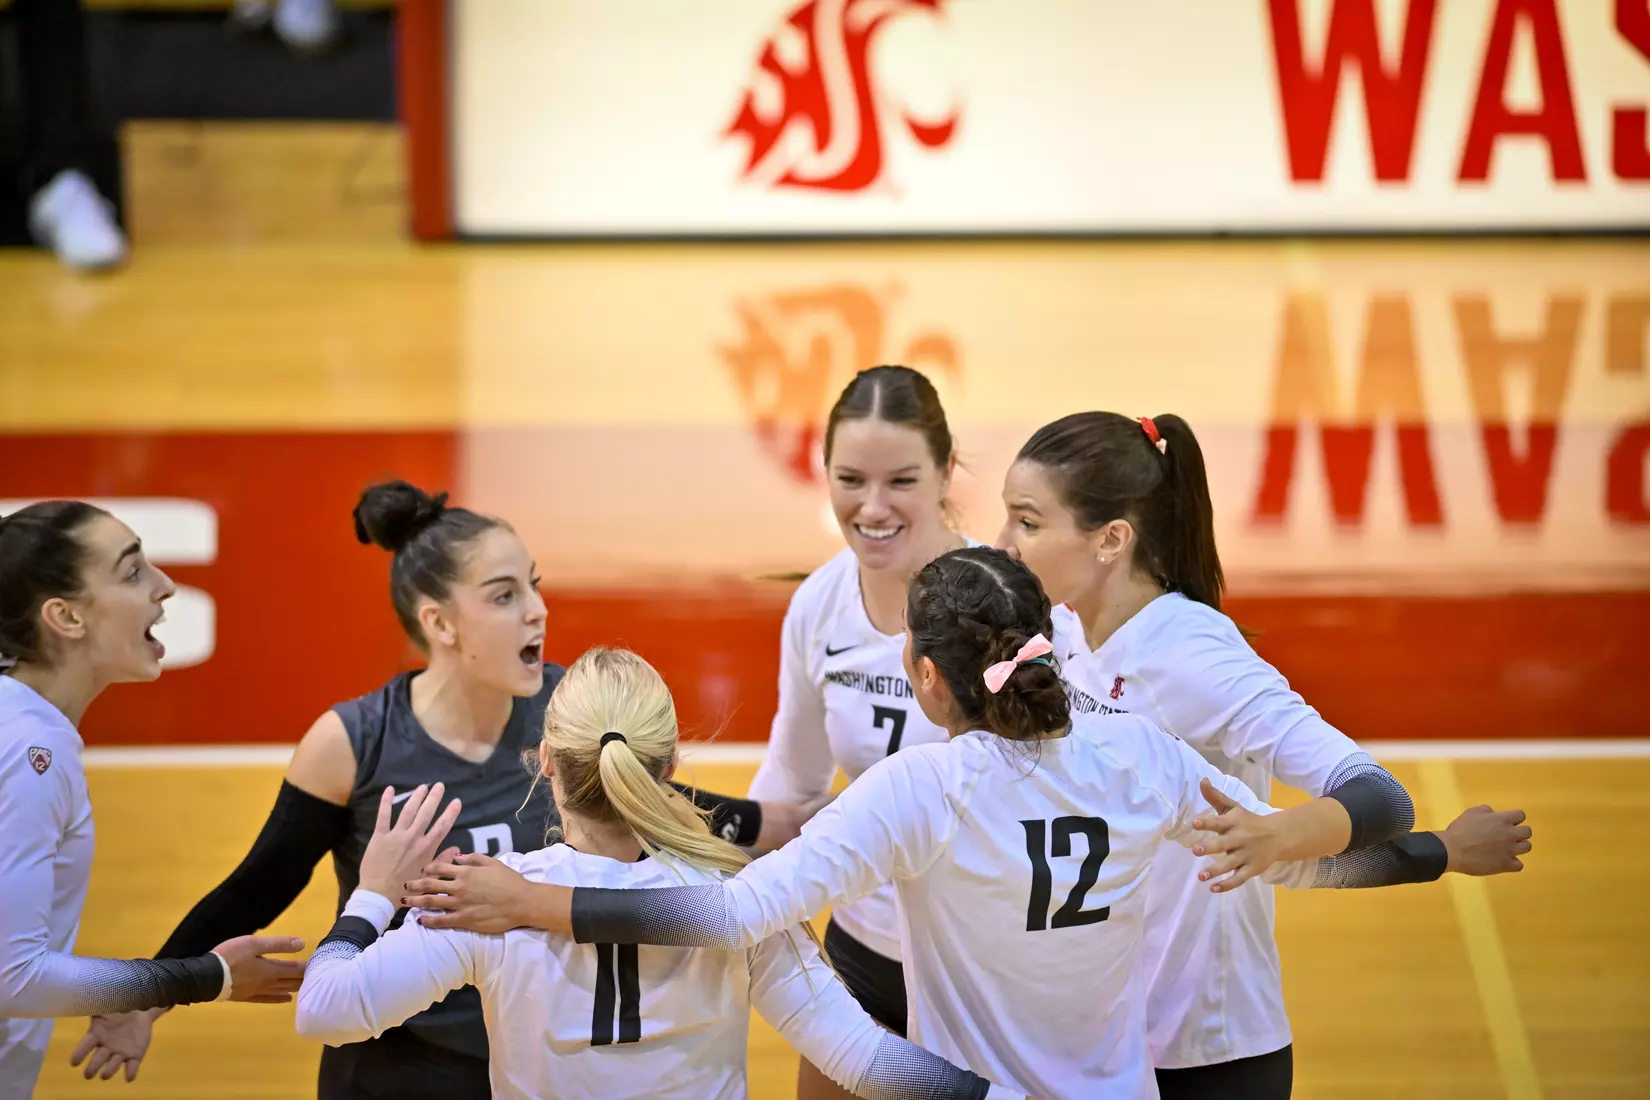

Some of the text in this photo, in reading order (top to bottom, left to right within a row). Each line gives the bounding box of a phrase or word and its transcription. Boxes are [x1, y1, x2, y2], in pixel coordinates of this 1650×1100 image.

[35, 761, 46, 771] 12
[871, 704, 907, 757] 7
[1018, 816, 1110, 931] 12
[591, 943, 641, 1046] 11
